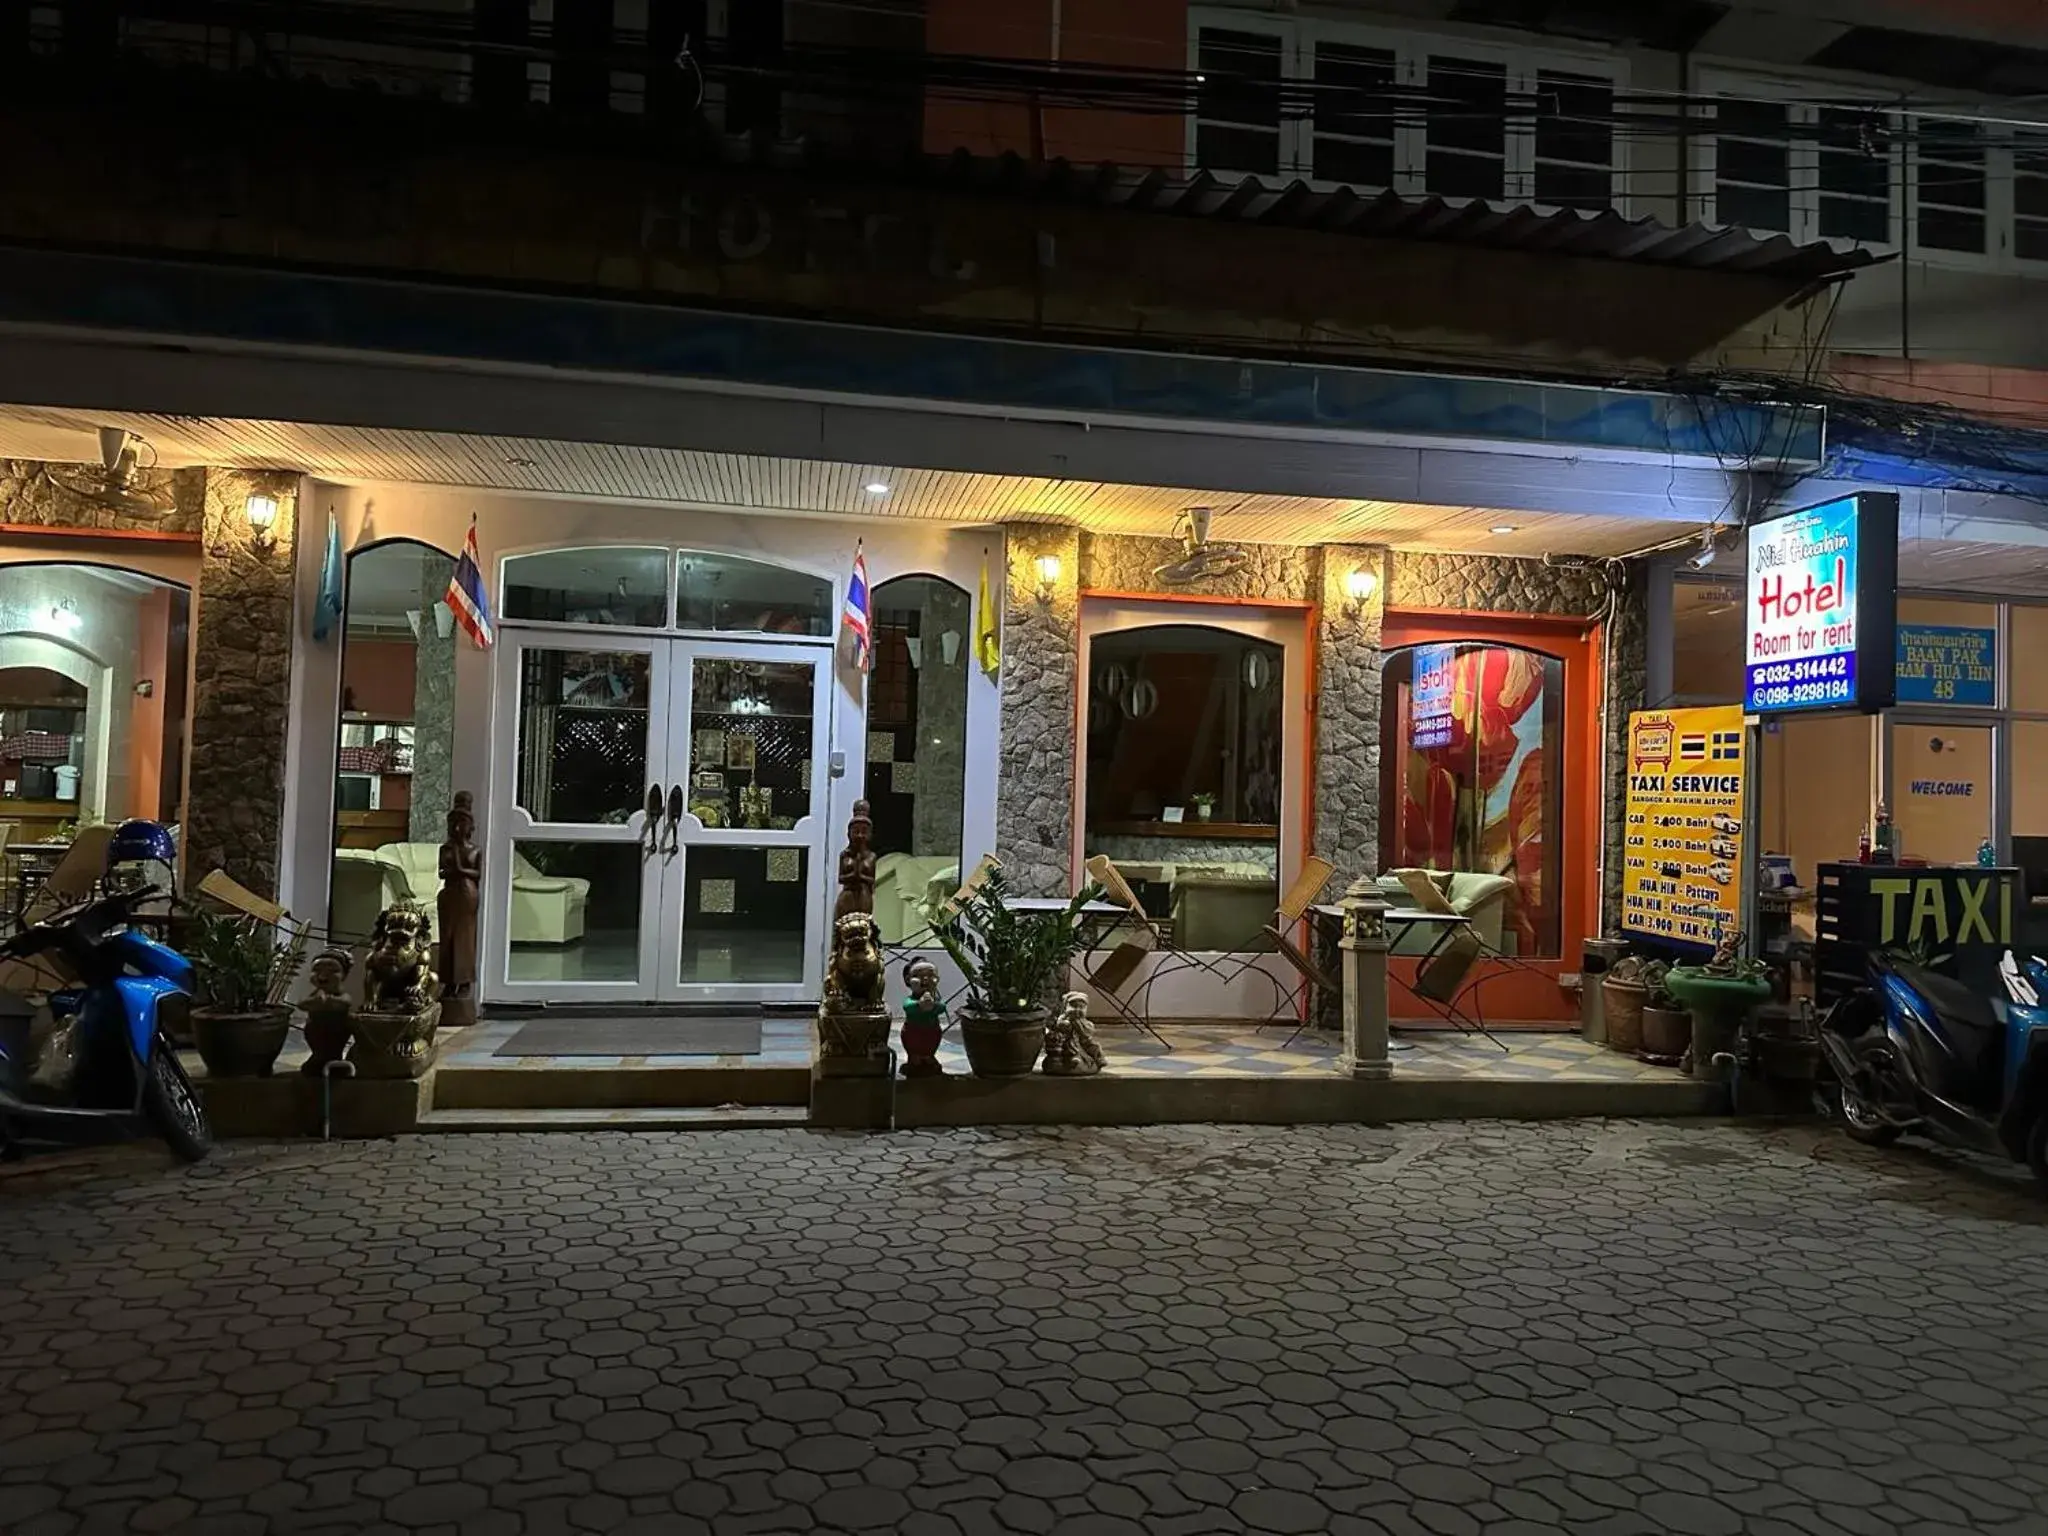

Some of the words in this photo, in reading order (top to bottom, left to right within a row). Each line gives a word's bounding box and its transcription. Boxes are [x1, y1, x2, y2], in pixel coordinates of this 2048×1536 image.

[1758, 558, 1844, 625] Hotel
[1754, 630, 1791, 657] Room
[1797, 626, 1816, 651] for
[1823, 622, 1852, 648] rent
[1907, 646, 1945, 663] BAAN
[1952, 649, 1980, 665] PAK
[1766, 656, 1846, 682] 032-514442
[1932, 664, 1962, 679] HUA
[1968, 665, 1993, 681] HIN
[1767, 679, 1848, 705] 098-9298184
[1933, 680, 1954, 700] 48
[1631, 776, 1665, 791] TAXI
[1672, 776, 1739, 793] SERVICE
[1911, 781, 1973, 796] WELCOME
[1628, 814, 1645, 824] CAR
[1686, 817, 1708, 828] Baht
[1627, 836, 1645, 846] CAR
[1684, 841, 1706, 851] Baht
[1627, 858, 1645, 868] VAN
[1685, 864, 1707, 875] Baht
[1639, 878, 1657, 892] HUA
[1660, 880, 1676, 895] HIN
[1685, 884, 1720, 903] Pattaya
[1626, 895, 1643, 909] HUA
[1646, 897, 1661, 911] HIN
[1628, 913, 1645, 926] CAR
[1680, 922, 1698, 937] VAN
